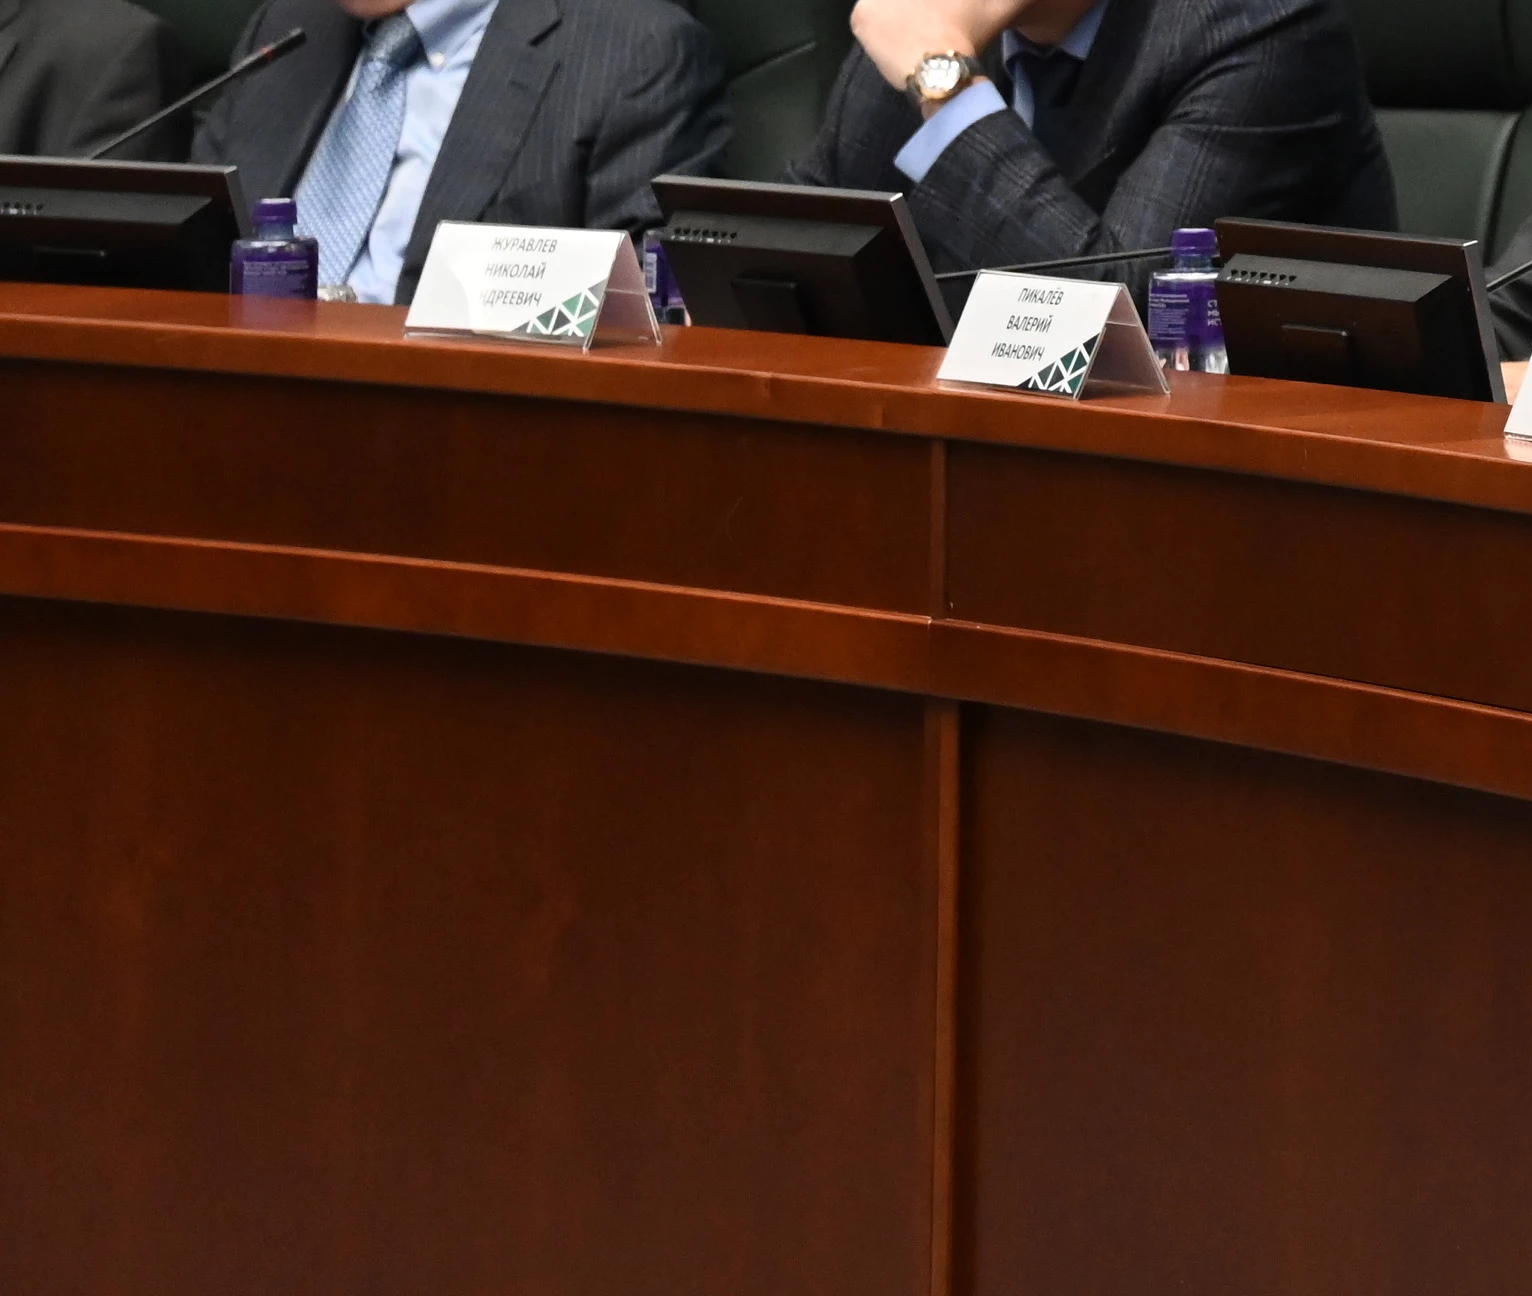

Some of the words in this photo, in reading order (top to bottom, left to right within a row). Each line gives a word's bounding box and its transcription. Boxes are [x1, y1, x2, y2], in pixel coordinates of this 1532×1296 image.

[491, 236, 558, 253] ЖУРАВЛЕВ
[484, 261, 547, 279] НИКОЛАЙ
[480, 289, 542, 307] НДРЕЕВИЧ
[1018, 286, 1064, 306] ПИКАЛЁВ
[1006, 314, 1053, 333] ВАЛЕРИЙ
[991, 342, 1046, 361] ИВАНОВИЧ
